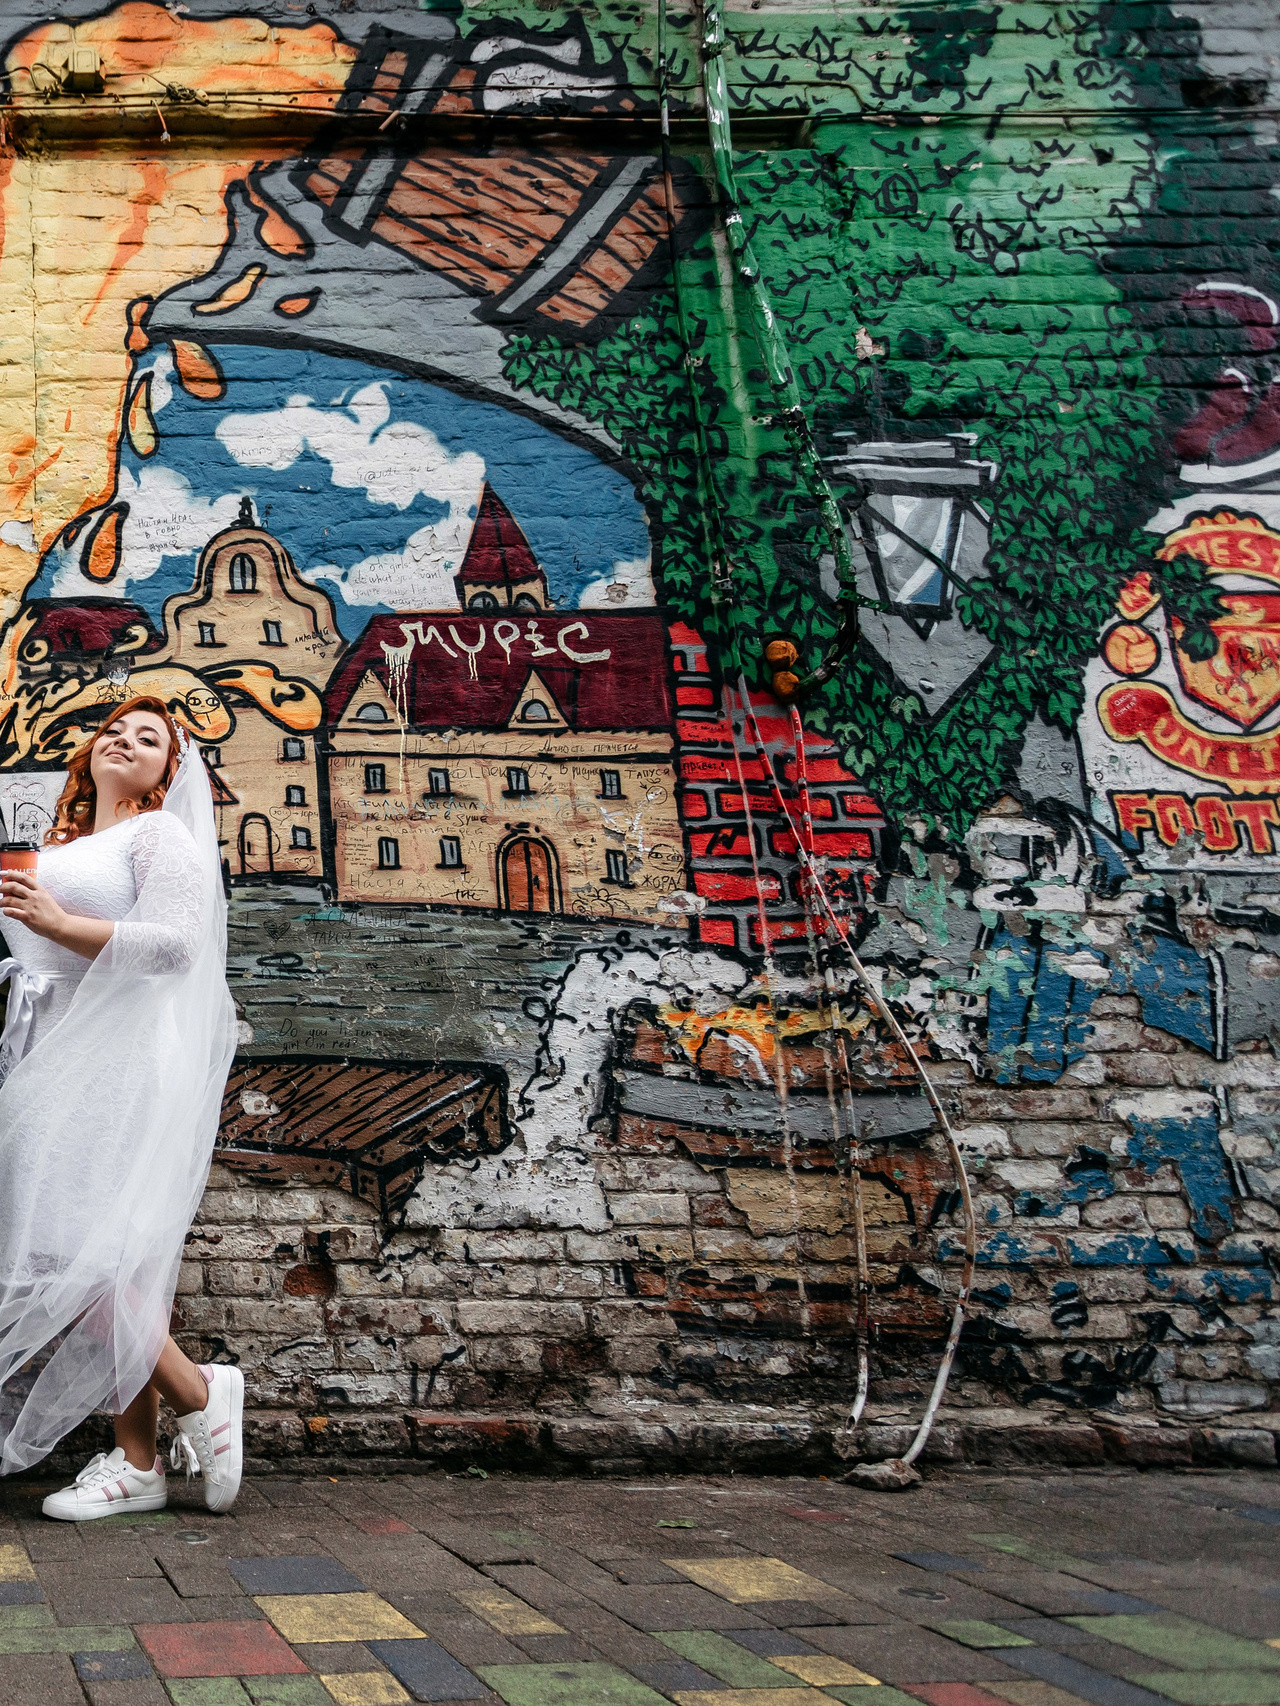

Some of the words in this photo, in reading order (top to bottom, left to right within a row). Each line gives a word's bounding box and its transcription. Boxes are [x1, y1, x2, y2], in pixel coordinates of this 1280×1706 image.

[641, 874, 677, 891] ЖОРА
[279, 1017, 298, 1038] Do
[309, 1028, 328, 1044] you
